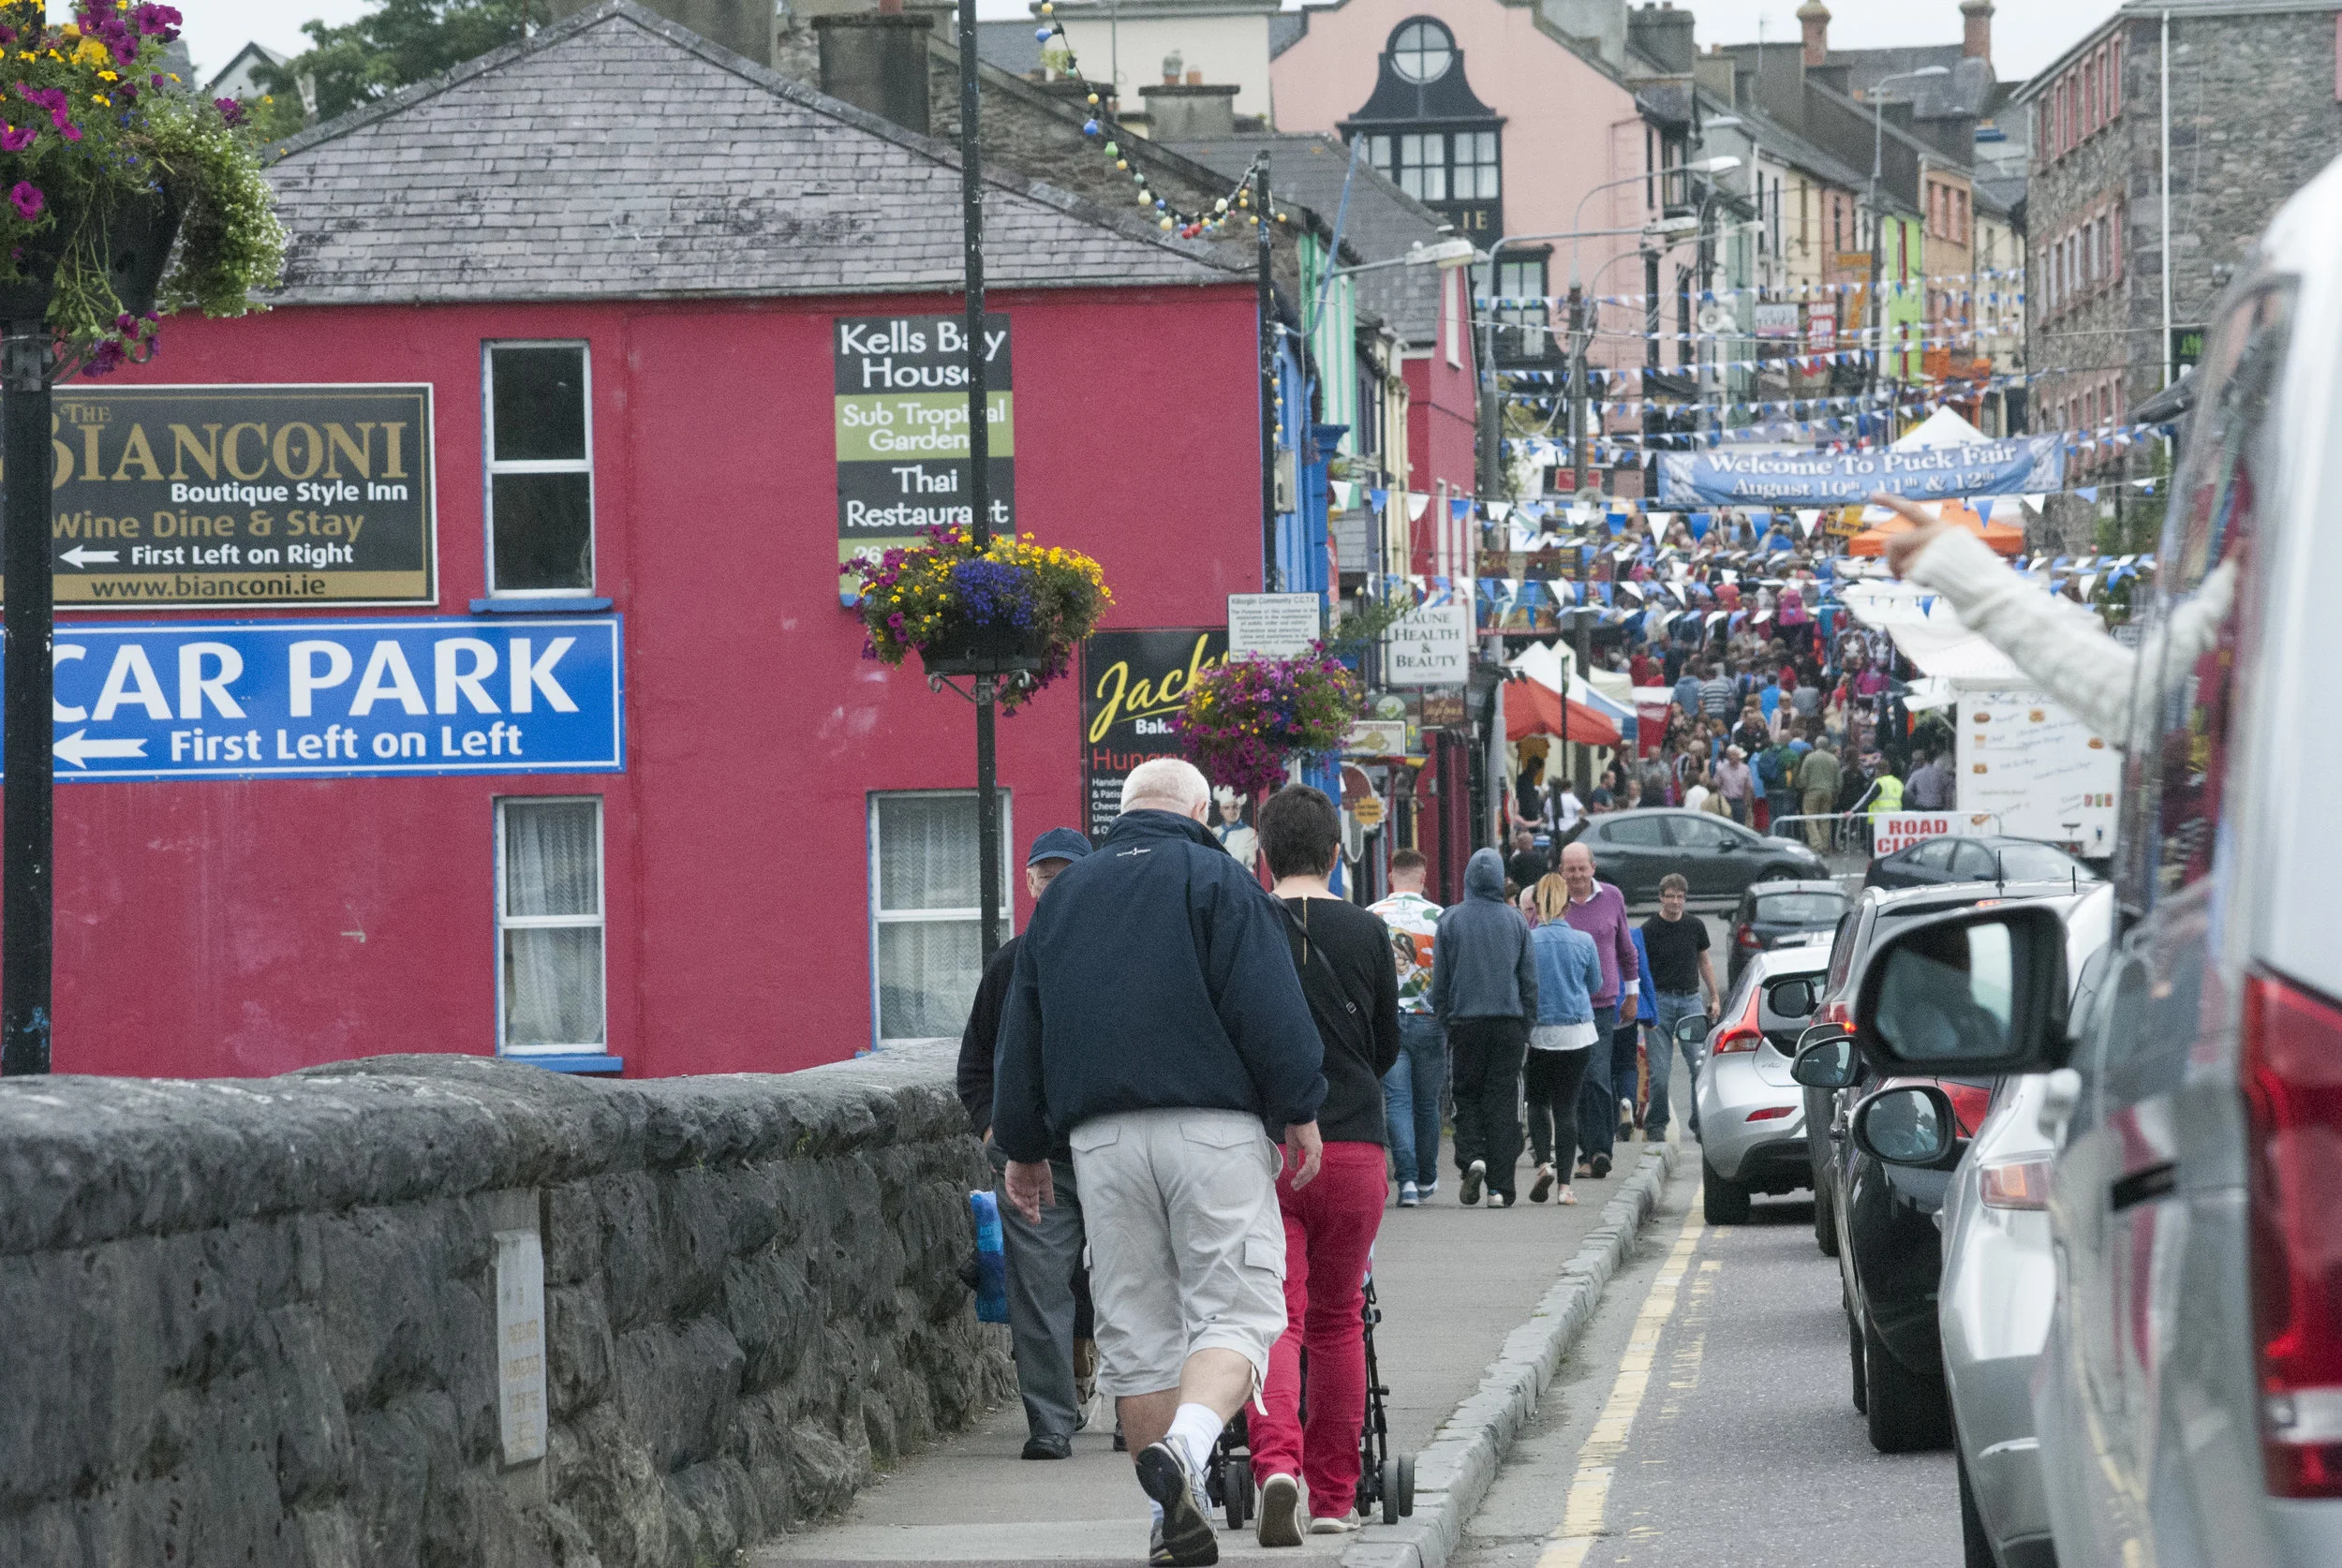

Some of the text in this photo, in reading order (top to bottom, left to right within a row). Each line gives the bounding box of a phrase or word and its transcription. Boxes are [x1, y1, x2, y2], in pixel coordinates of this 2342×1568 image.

[840, 320, 927, 355] Kells
[60, 403, 112, 423] THE
[843, 398, 1005, 431] Sub Tropial
[868, 426, 971, 451] Garden
[1708, 443, 2018, 476] Welcome To Puck Fair
[171, 480, 408, 507] Boutique Style Inn
[892, 465, 958, 495] Thai
[1731, 478, 1814, 499] August
[1925, 473, 1948, 493] &
[1955, 470, 1996, 490] 12th
[52, 509, 364, 543] Wine Dine & Stay
[847, 499, 1010, 528] Restaurat
[131, 542, 354, 569] First Left on Right
[91, 573, 326, 598] www.bianconi.ie
[1403, 612, 1451, 625] LAUNE
[1394, 629, 1460, 642] HEALTH
[1421, 643, 1432, 654] &
[1396, 655, 1459, 668] BEAUTY
[52, 637, 580, 723] CAR PARK
[171, 721, 524, 762] First Left on Left
[1092, 777, 1125, 787] Handm
[1889, 819, 1949, 836] ROAD
[1876, 836, 1928, 853] CLO
